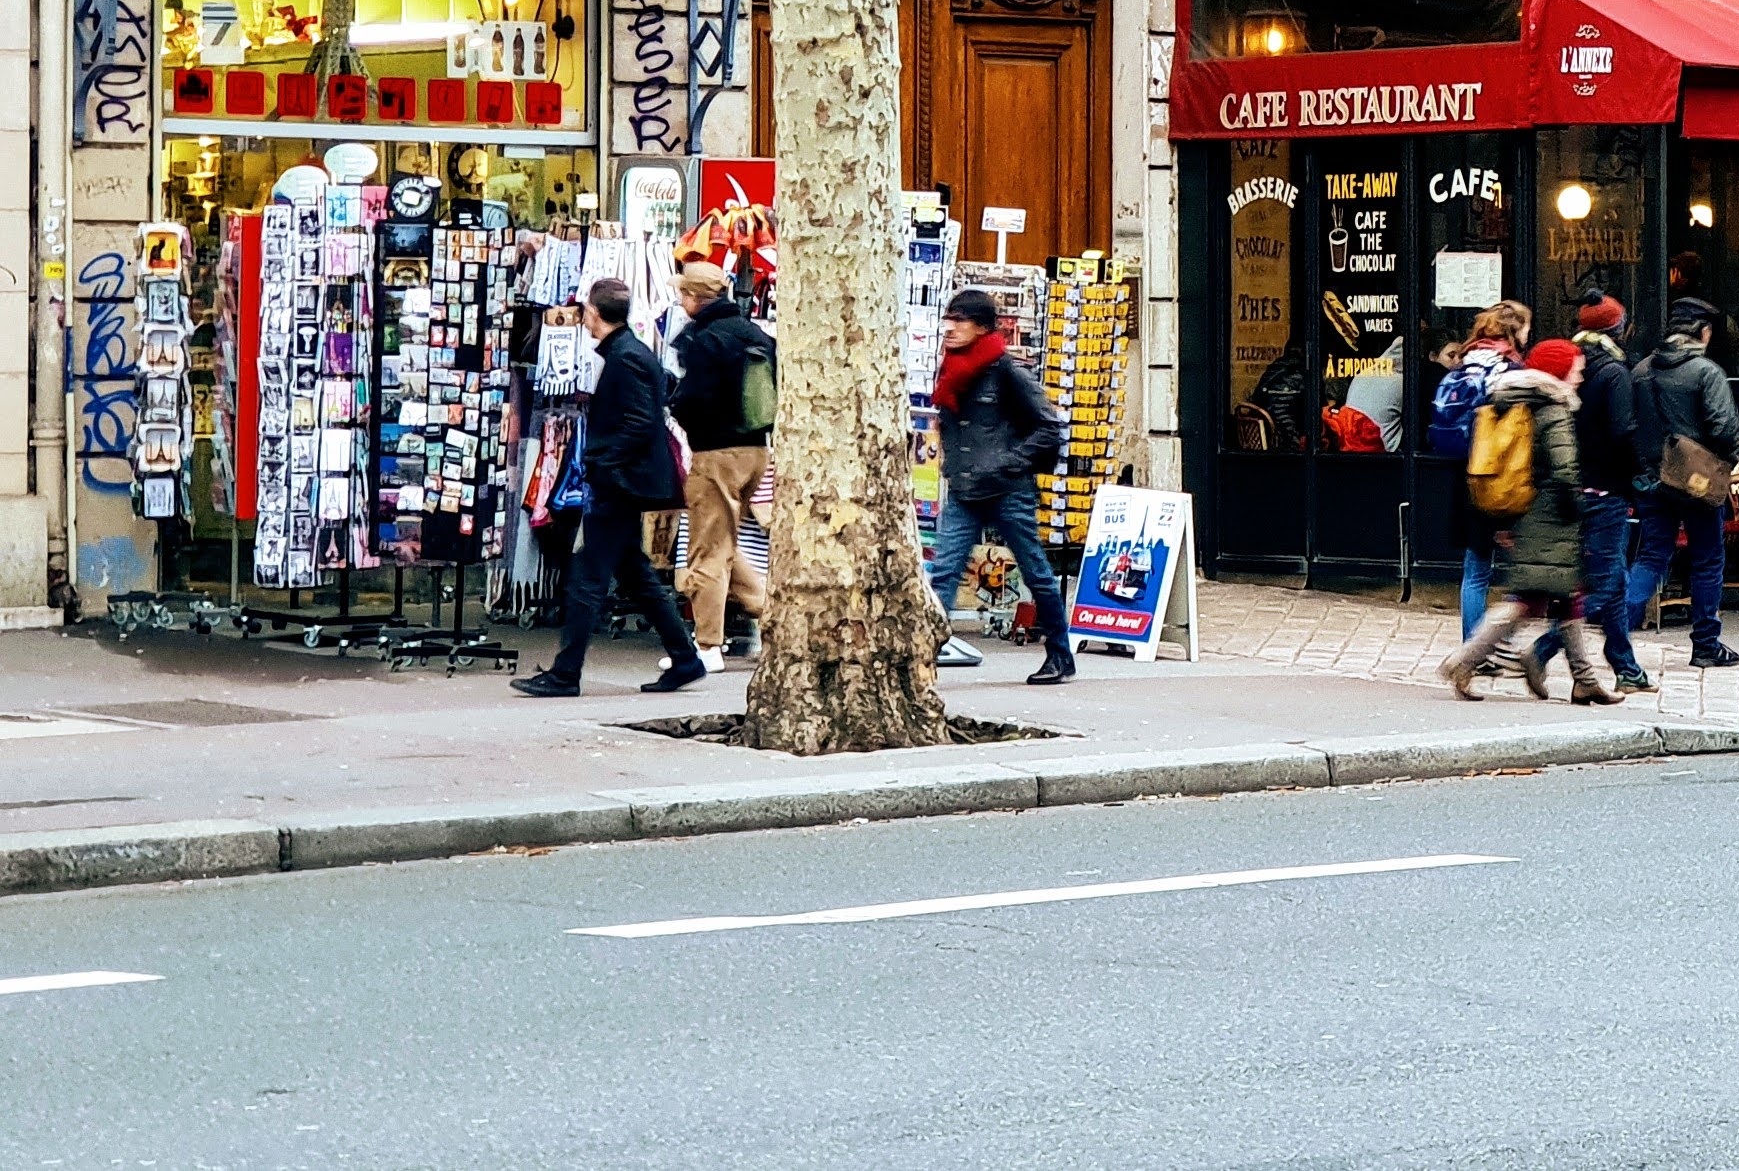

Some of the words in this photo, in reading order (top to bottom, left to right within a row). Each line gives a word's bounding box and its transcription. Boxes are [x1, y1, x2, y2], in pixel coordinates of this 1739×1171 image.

[1560, 46, 1614, 73] L'ANNEXE
[1219, 92, 1290, 129] CAFE
[1298, 82, 1482, 126] RESTAURANT
[1325, 172, 1398, 200] TAKE-AWAY
[1227, 176, 1299, 216] BRASSERIE
[1354, 211, 1387, 230] CAFE
[1235, 235, 1285, 261] CHOCOLAT
[1359, 232, 1383, 251] THE
[1349, 254, 1397, 273] CHOCOLAT
[1346, 295, 1399, 313] SANDWICHES
[1364, 318, 1394, 333] VARIES
[1326, 353, 1335, 378] À
[1337, 357, 1395, 379] EMPORTER
[1104, 514, 1126, 524] BUS
[1078, 610, 1092, 623] On
[1094, 613, 1115, 626] sale
[1116, 615, 1142, 629] here!
